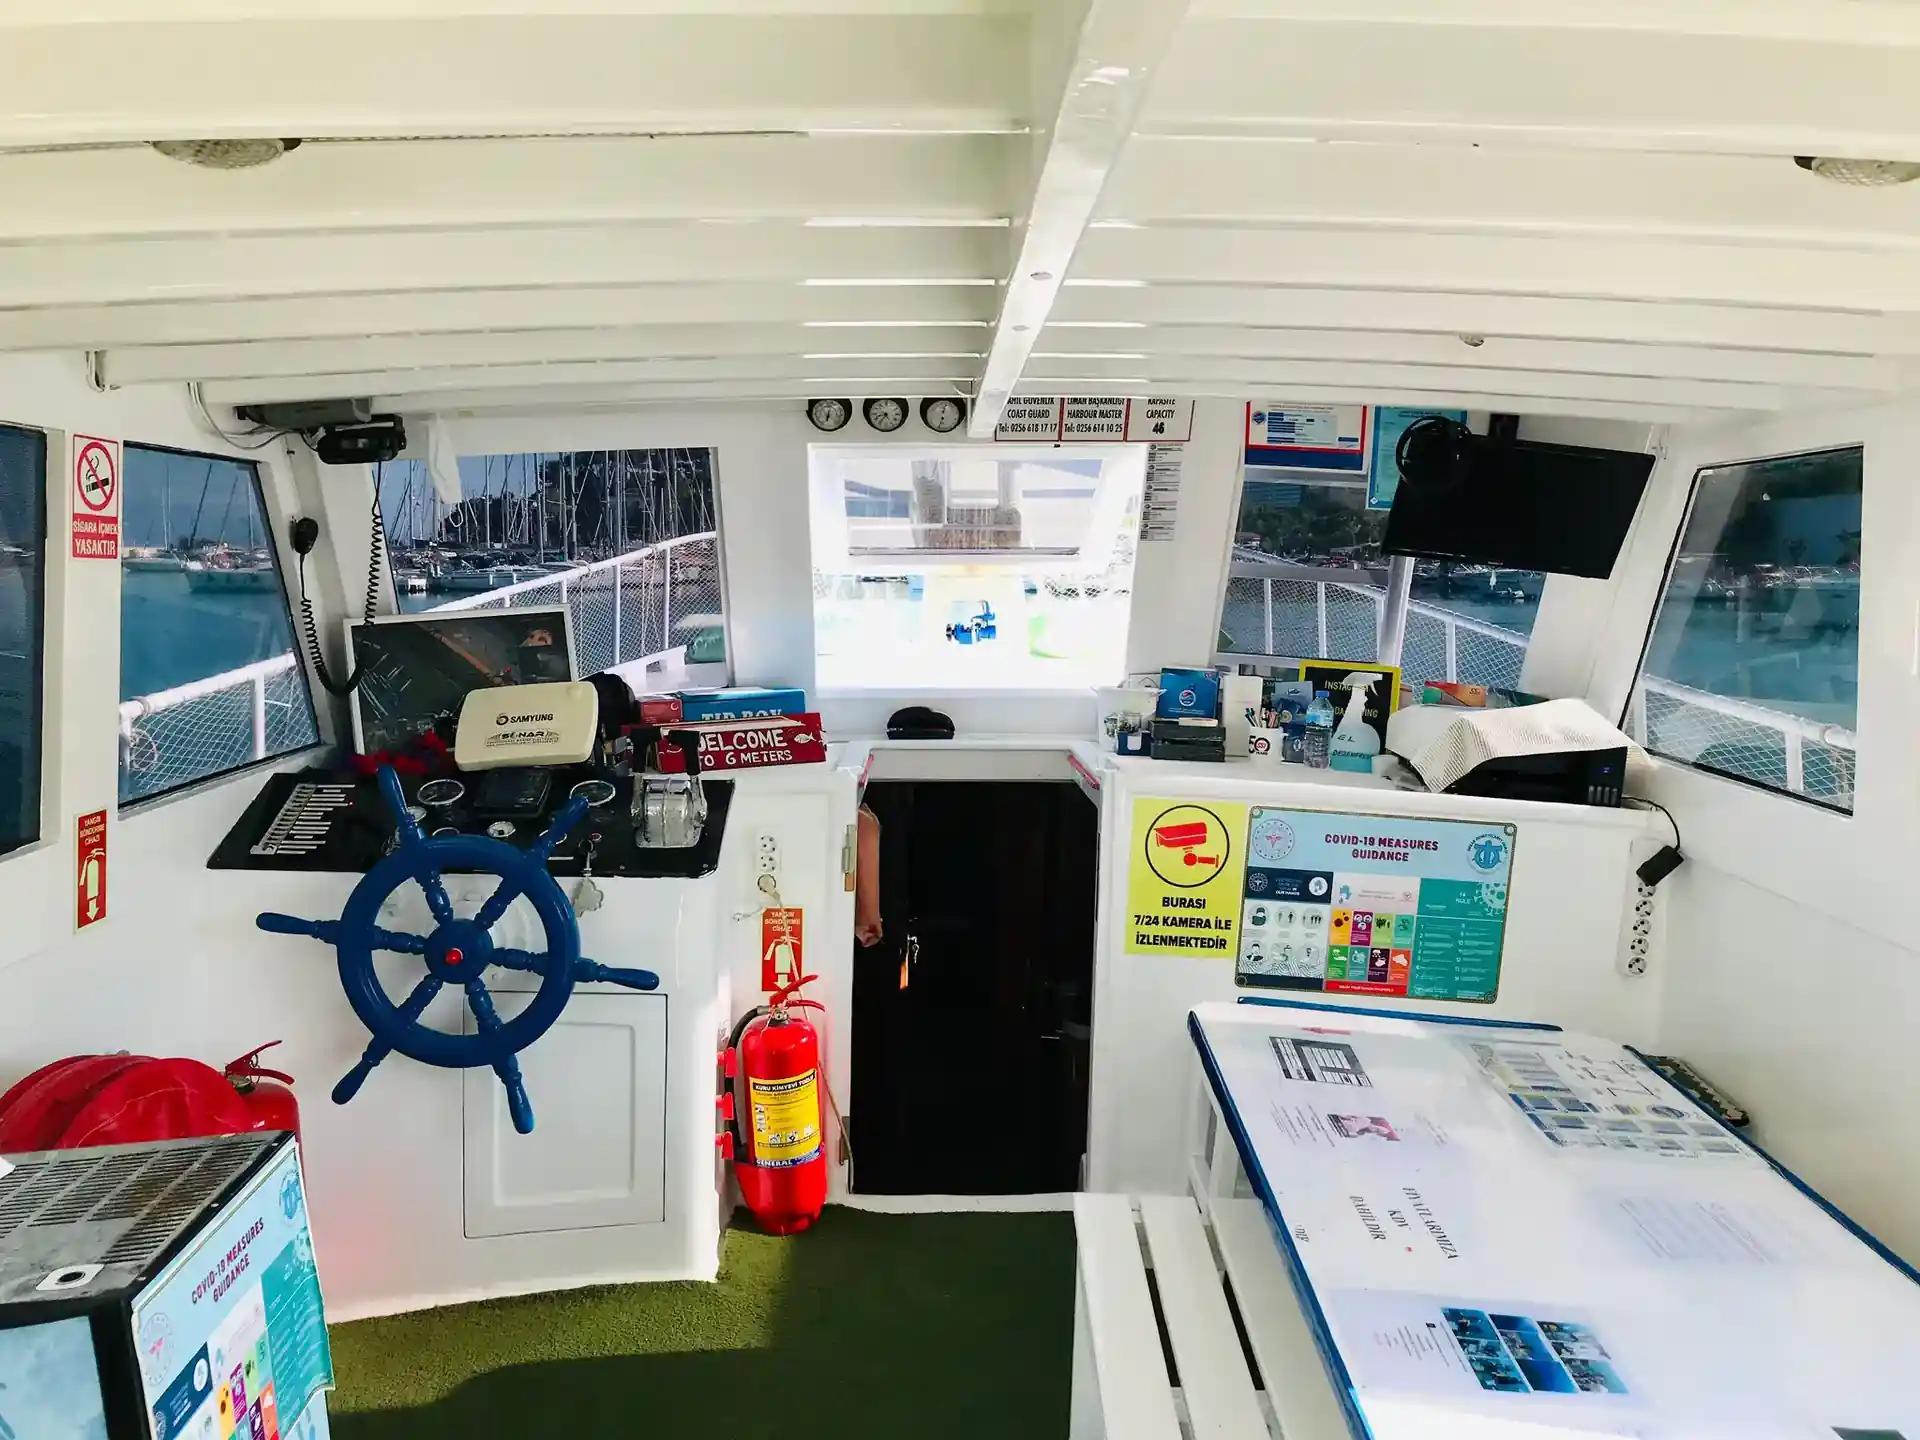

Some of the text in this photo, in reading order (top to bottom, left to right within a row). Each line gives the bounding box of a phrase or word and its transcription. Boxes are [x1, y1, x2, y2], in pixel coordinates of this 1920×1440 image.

[1007, 409, 1050, 419] COAST GUARD
[1067, 409, 1123, 419] HARBOUR MASTER
[1146, 409, 1176, 419] CAPACITY
[1010, 423, 1027, 433] 0256
[1027, 423, 1039, 433] 618
[1076, 423, 1092, 433] 0256
[1092, 423, 1105, 433] 614
[1106, 423, 1114, 433] 10
[1114, 423, 1123, 433] 25
[1152, 421, 1165, 435] 46
[75, 538, 116, 556] YASAKTIR
[510, 713, 553, 724] SAMYUNG
[740, 749, 793, 764] METERS
[1324, 833, 1440, 851] COVID-19 MEASURES
[1351, 848, 1410, 862] GUIDANCE
[1162, 896, 1207, 909] BURASI
[1134, 914, 1233, 930] 7/24 KAMERA İLE
[1135, 931, 1228, 950] İZLENMEKTEDİR
[191, 1216, 265, 1305] COVID-19 MEASURES
[212, 1252, 251, 1304] GUIDANCE
